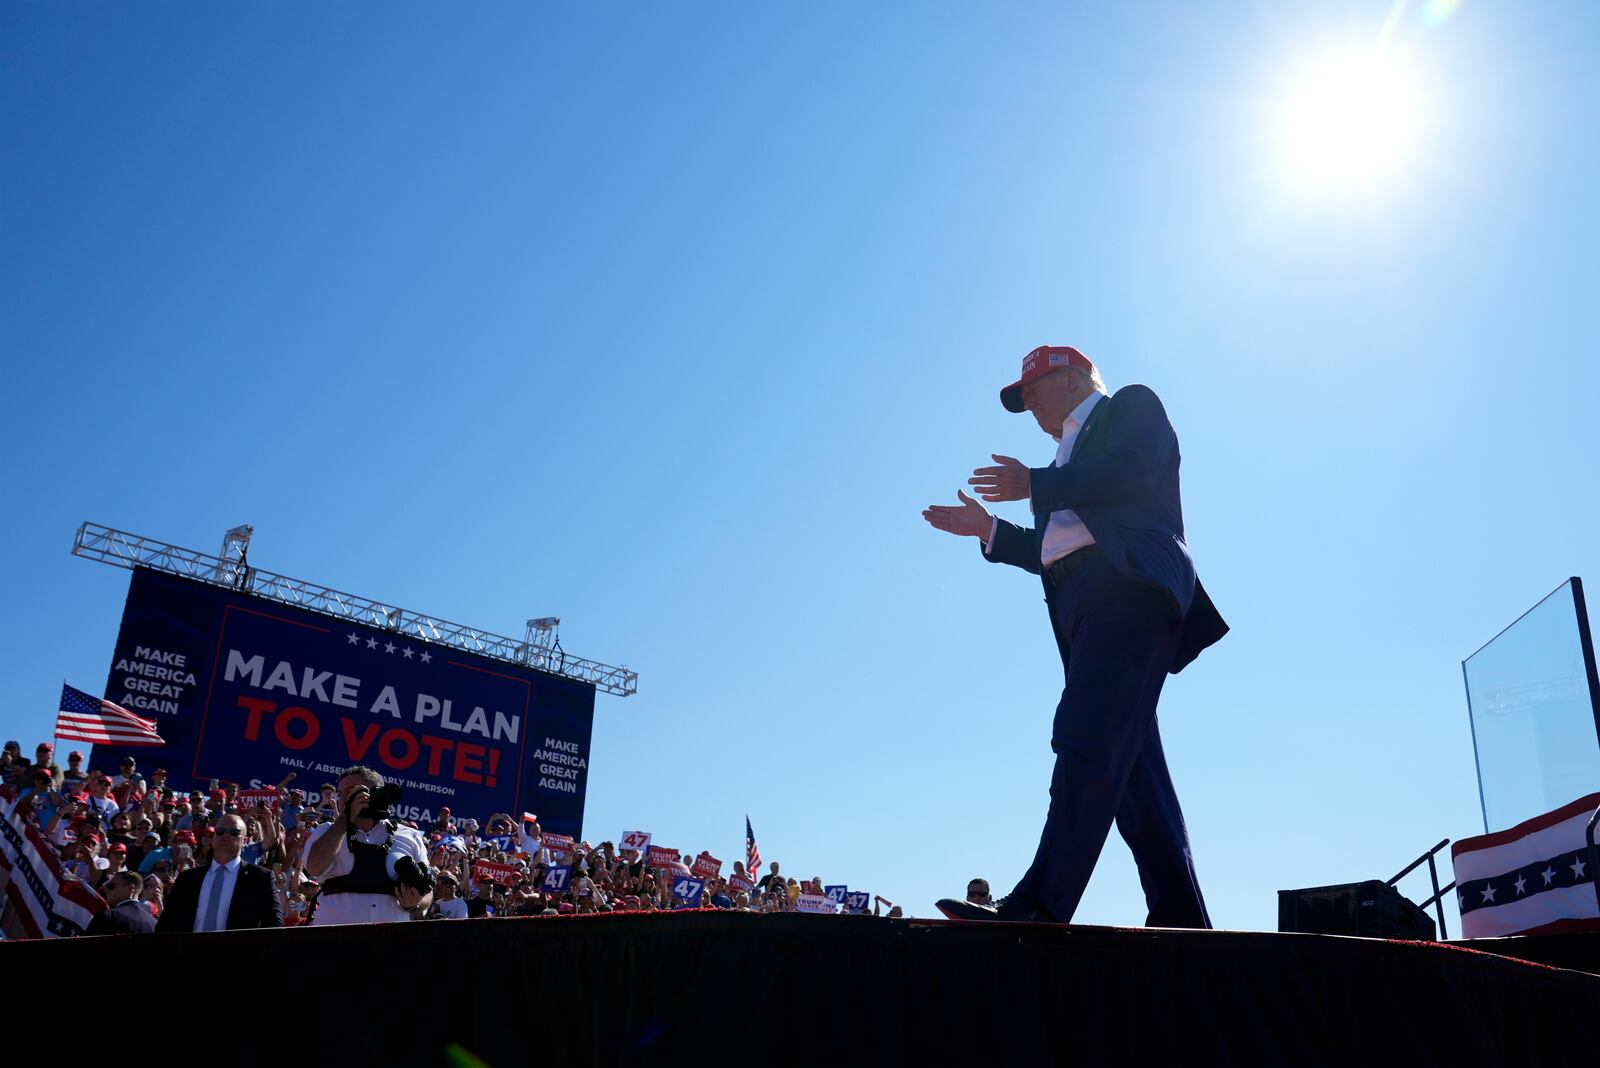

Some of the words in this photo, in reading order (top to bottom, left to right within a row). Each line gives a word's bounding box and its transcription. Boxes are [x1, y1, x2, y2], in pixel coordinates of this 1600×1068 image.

[134, 646, 187, 668] MAKE
[115, 658, 197, 686] AMERICA
[123, 677, 184, 699] GREAT
[223, 649, 361, 709] MAKE
[370, 685, 402, 719] A
[414, 693, 520, 744] PLAN
[120, 693, 179, 715] AGAIN
[237, 696, 320, 750] TO
[340, 716, 501, 788] VOTE!
[544, 737, 579, 754] MAKE
[532, 748, 587, 770] AMERICA
[280, 756, 306, 769] MAIL
[381, 774, 406, 786] ARLY
[406, 780, 456, 796] IN-PERSON
[539, 764, 579, 781] GREAT
[538, 776, 577, 794] AGAIN
[240, 795, 278, 803] TRUMP
[624, 833, 648, 848] 47
[651, 852, 677, 860] TRUMP
[698, 858, 720, 870] TRUMP
[477, 866, 511, 878] TRUMP
[544, 868, 567, 888] 47
[674, 880, 700, 898] 47
[828, 888, 845, 901] 47
[850, 894, 867, 908] 47
